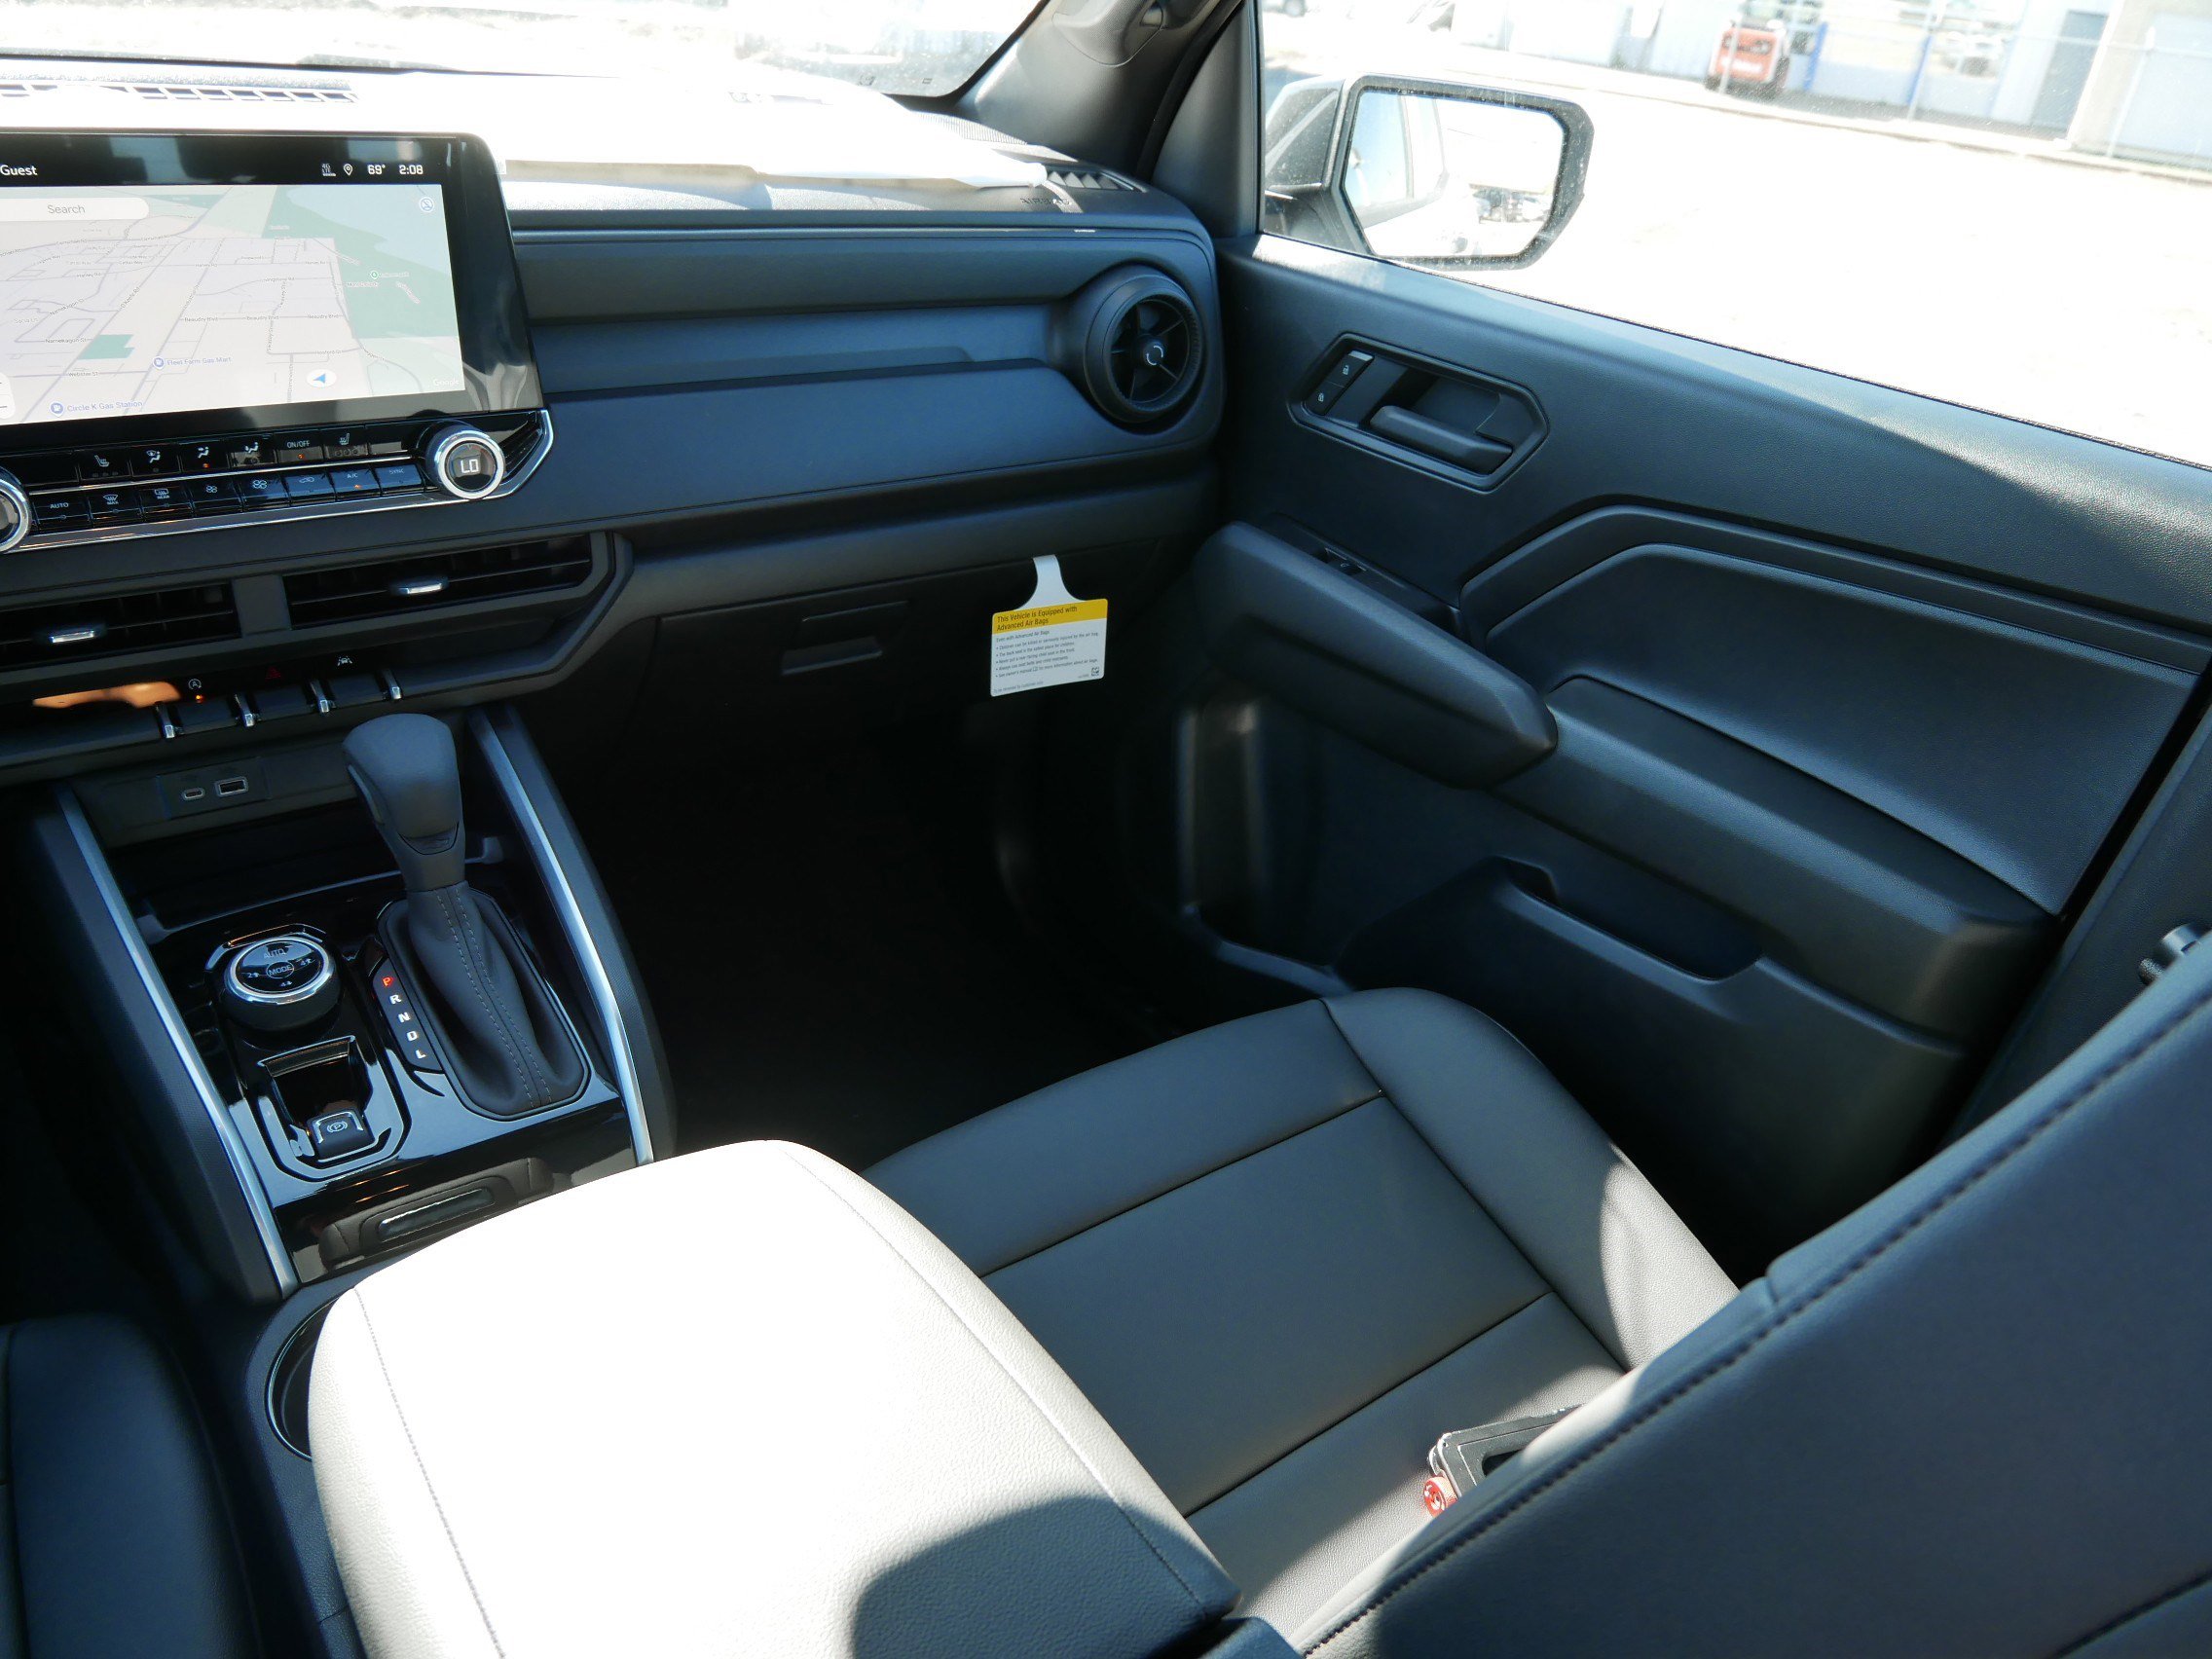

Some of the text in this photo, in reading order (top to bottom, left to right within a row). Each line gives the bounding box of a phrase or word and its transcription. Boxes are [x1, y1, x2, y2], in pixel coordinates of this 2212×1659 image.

[0, 165, 38, 176] Guest
[366, 164, 387, 175] 69°
[398, 165, 424, 175] 2:08
[47, 203, 86, 214] Search
[432, 378, 460, 387] Google
[67, 404, 90, 413] Circle
[116, 400, 143, 409] Station
[286, 440, 311, 449] ON/OFF
[460, 459, 479, 473] LO
[50, 501, 69, 510] AUTO
[1038, 608, 1063, 616] Equipped
[997, 621, 1023, 631] Advanced
[1034, 617, 1049, 626] Bags
[263, 947, 286, 959] AUTO
[268, 965, 292, 976] MODE
[382, 977, 392, 987] P
[389, 994, 402, 1004] R
[397, 1012, 411, 1023] N
[406, 1030, 419, 1042] D
[415, 1050, 426, 1059] L
